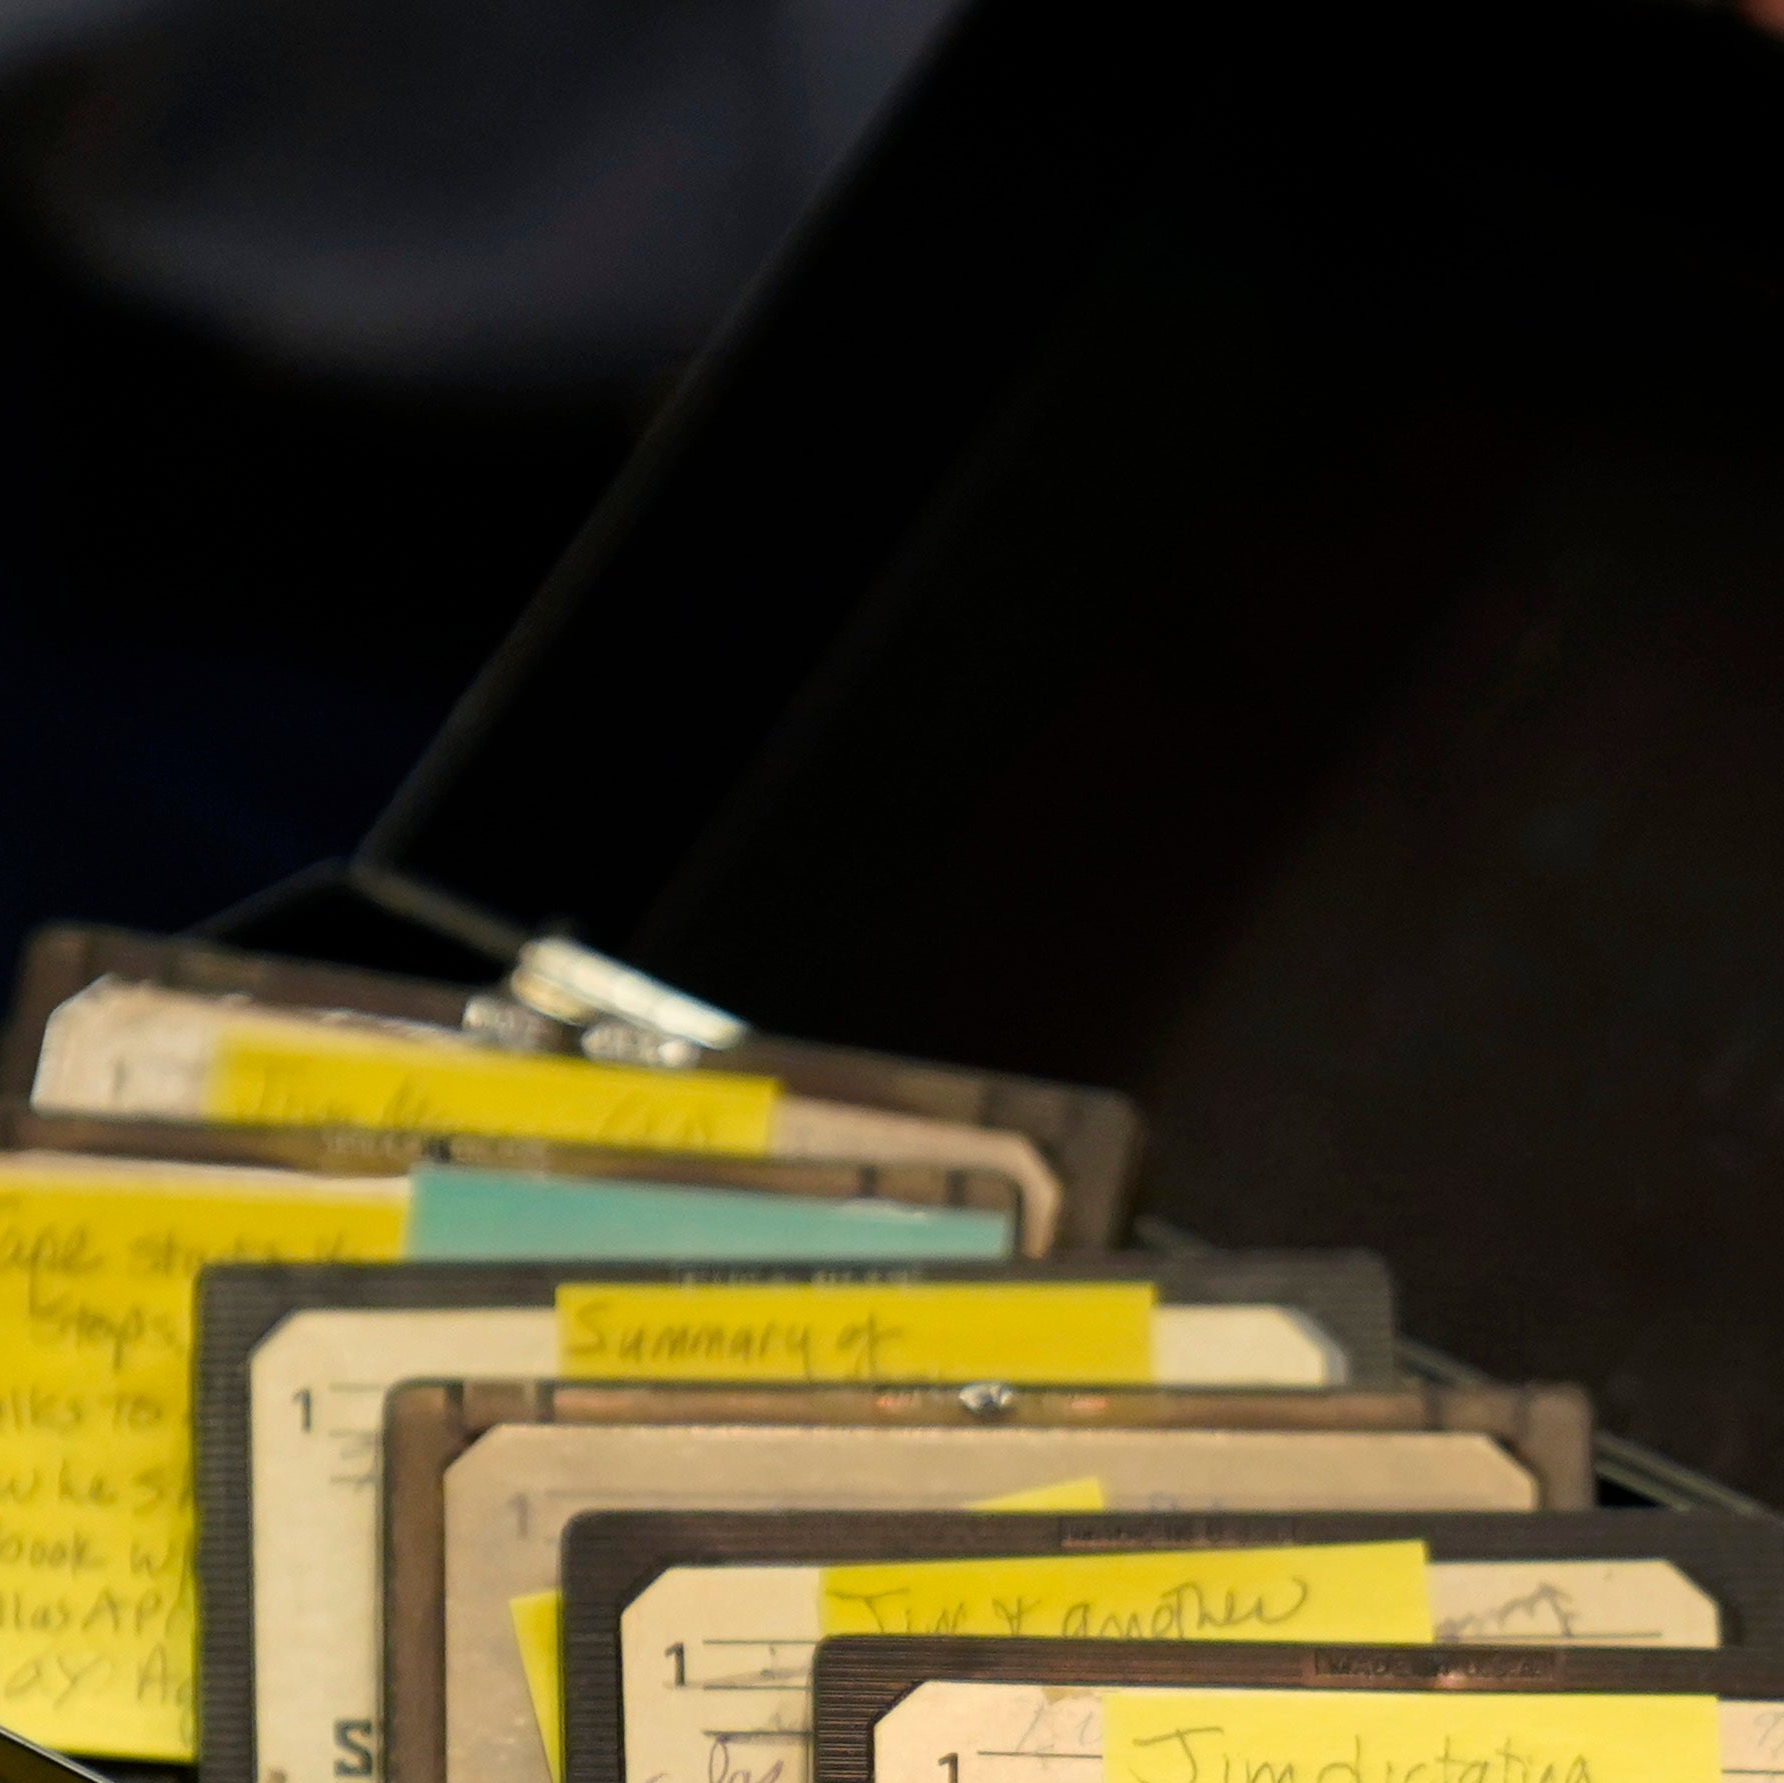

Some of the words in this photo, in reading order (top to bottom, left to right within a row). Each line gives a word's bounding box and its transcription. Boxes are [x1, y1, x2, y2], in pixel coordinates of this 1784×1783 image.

[567, 1300, 812, 1382] Summary
[293, 1388, 313, 1433] 1
[503, 1491, 529, 1540] 1
[664, 1642, 687, 1687] 1
